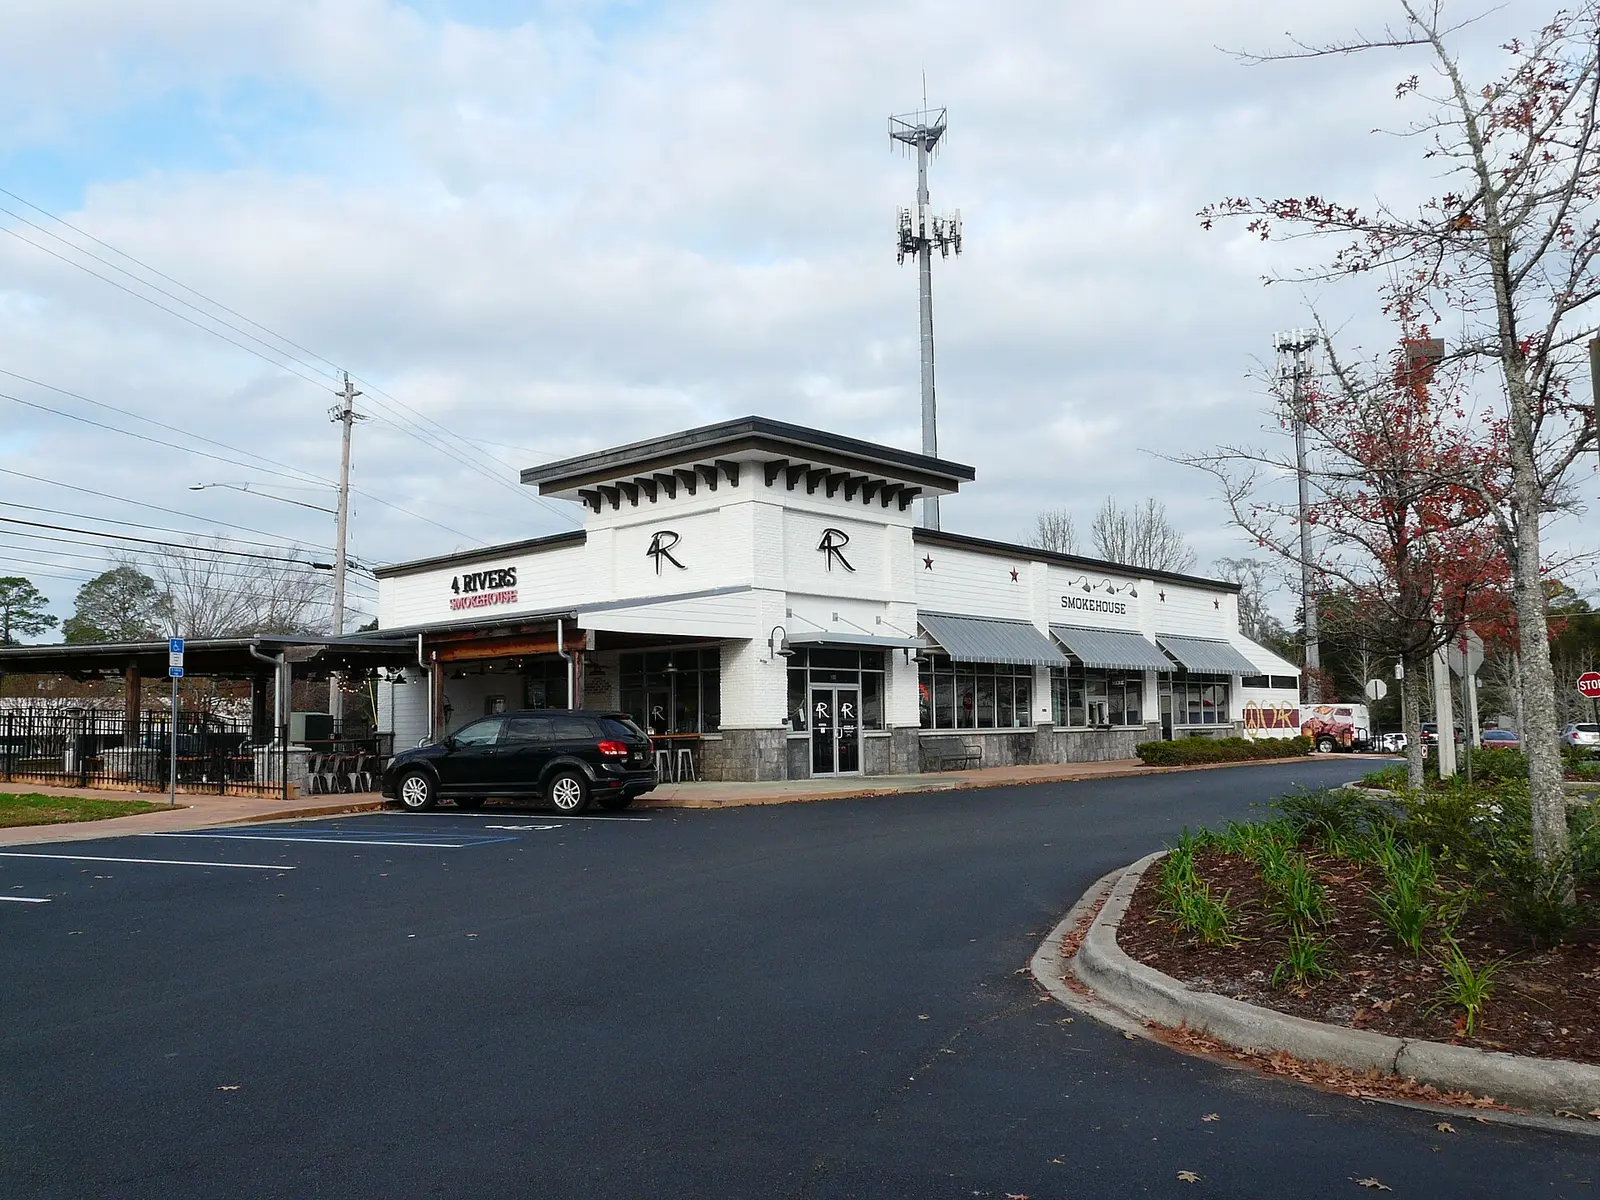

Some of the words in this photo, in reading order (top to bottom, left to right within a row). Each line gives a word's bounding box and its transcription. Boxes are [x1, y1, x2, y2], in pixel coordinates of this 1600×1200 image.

[451, 576, 460, 595] 4
[462, 566, 517, 593] RIVERS
[449, 590, 518, 611] SMOKEHOUSE
[1061, 595, 1126, 615] SMOKEHOUSE
